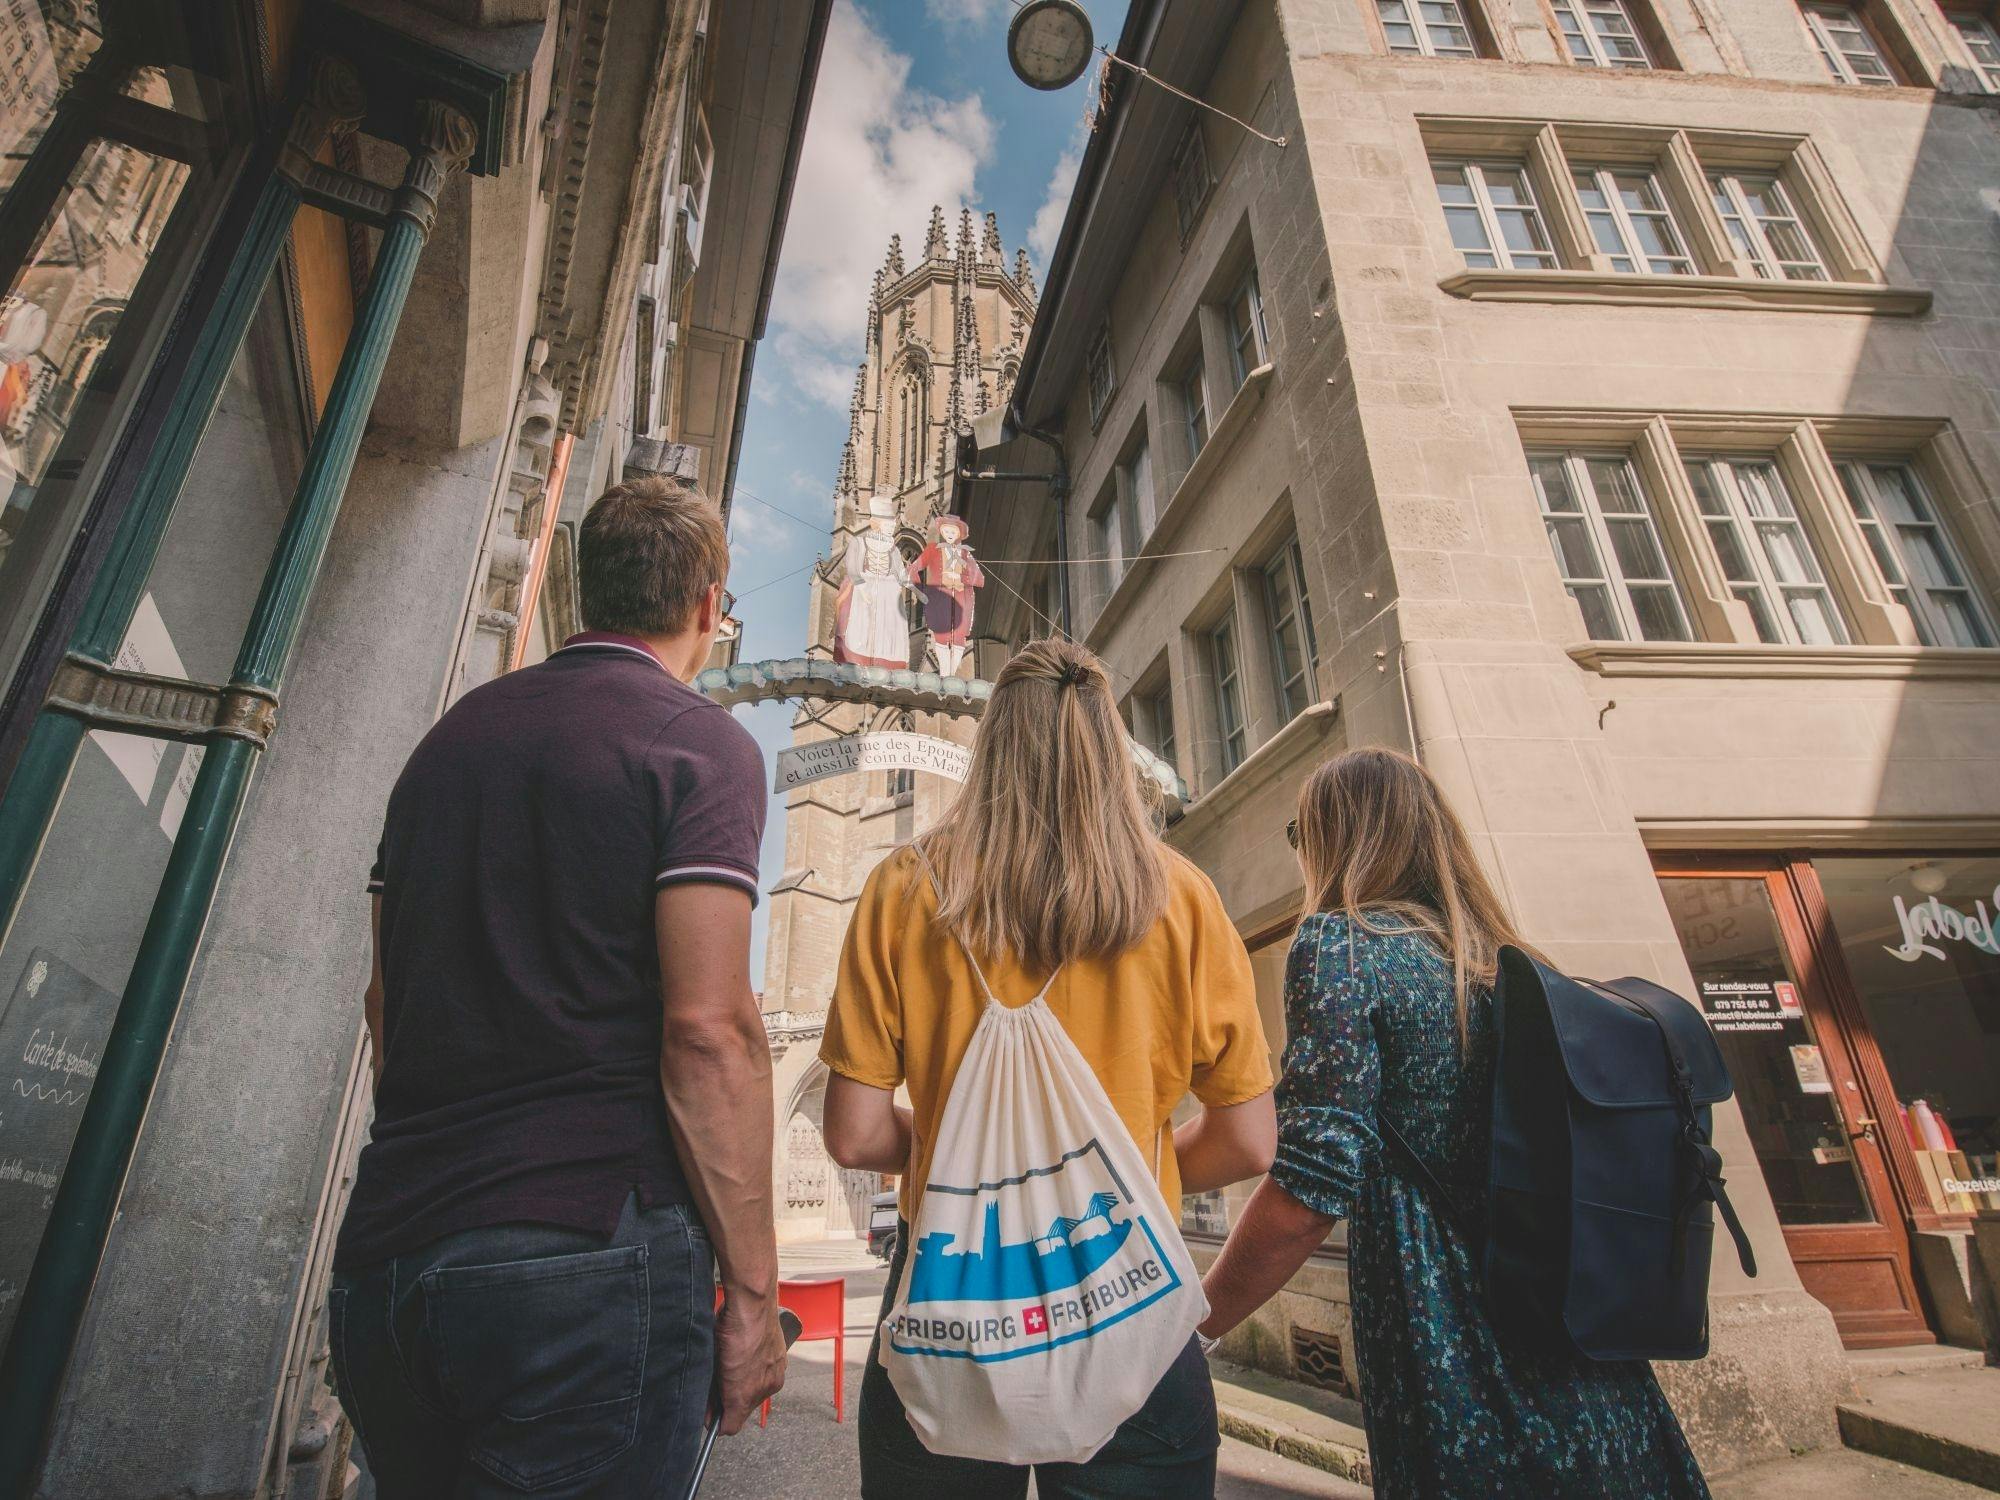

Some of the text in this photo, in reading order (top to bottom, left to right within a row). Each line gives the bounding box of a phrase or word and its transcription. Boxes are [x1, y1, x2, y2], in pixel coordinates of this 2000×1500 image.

[795, 738, 969, 765] Voici la rue des Epouse
[786, 751, 966, 783] et aussi le coin des Mari
[1892, 886, 2000, 960] Label
[1703, 982, 1770, 991] Sur rendez-vous
[1714, 1021, 1784, 1031] www.labeleau.ch
[898, 1259, 1162, 1343] FRIBOURG FREIBURG
